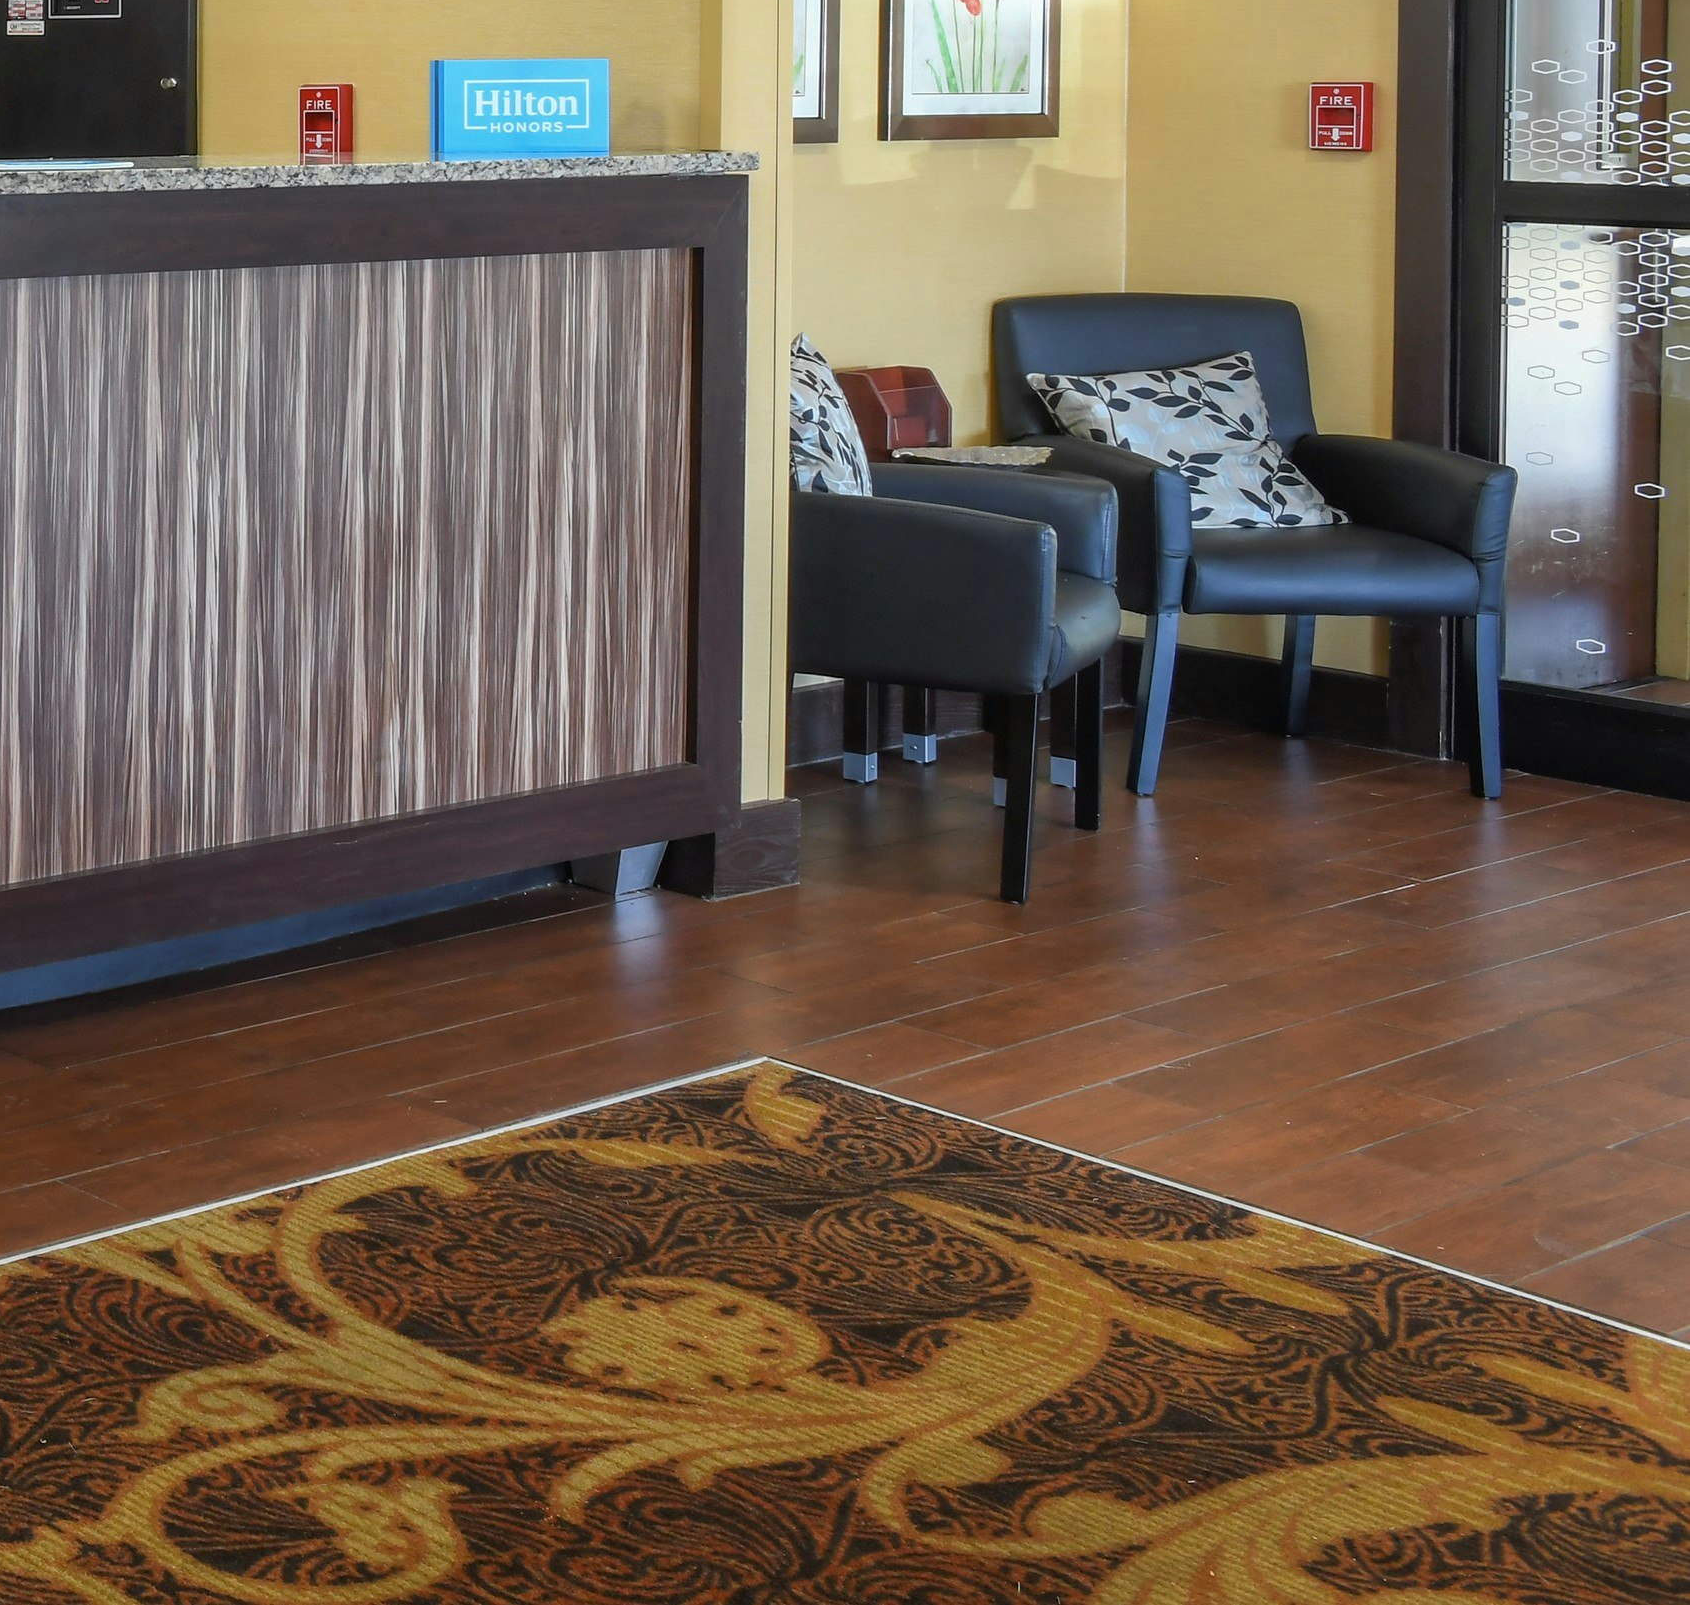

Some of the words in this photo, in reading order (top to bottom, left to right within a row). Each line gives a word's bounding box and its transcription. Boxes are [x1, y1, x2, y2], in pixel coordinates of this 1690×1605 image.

[306, 99, 333, 110] FIRE
[474, 89, 579, 116] Hilton
[1320, 96, 1353, 105] FIRE
[490, 121, 564, 133] HONORS
